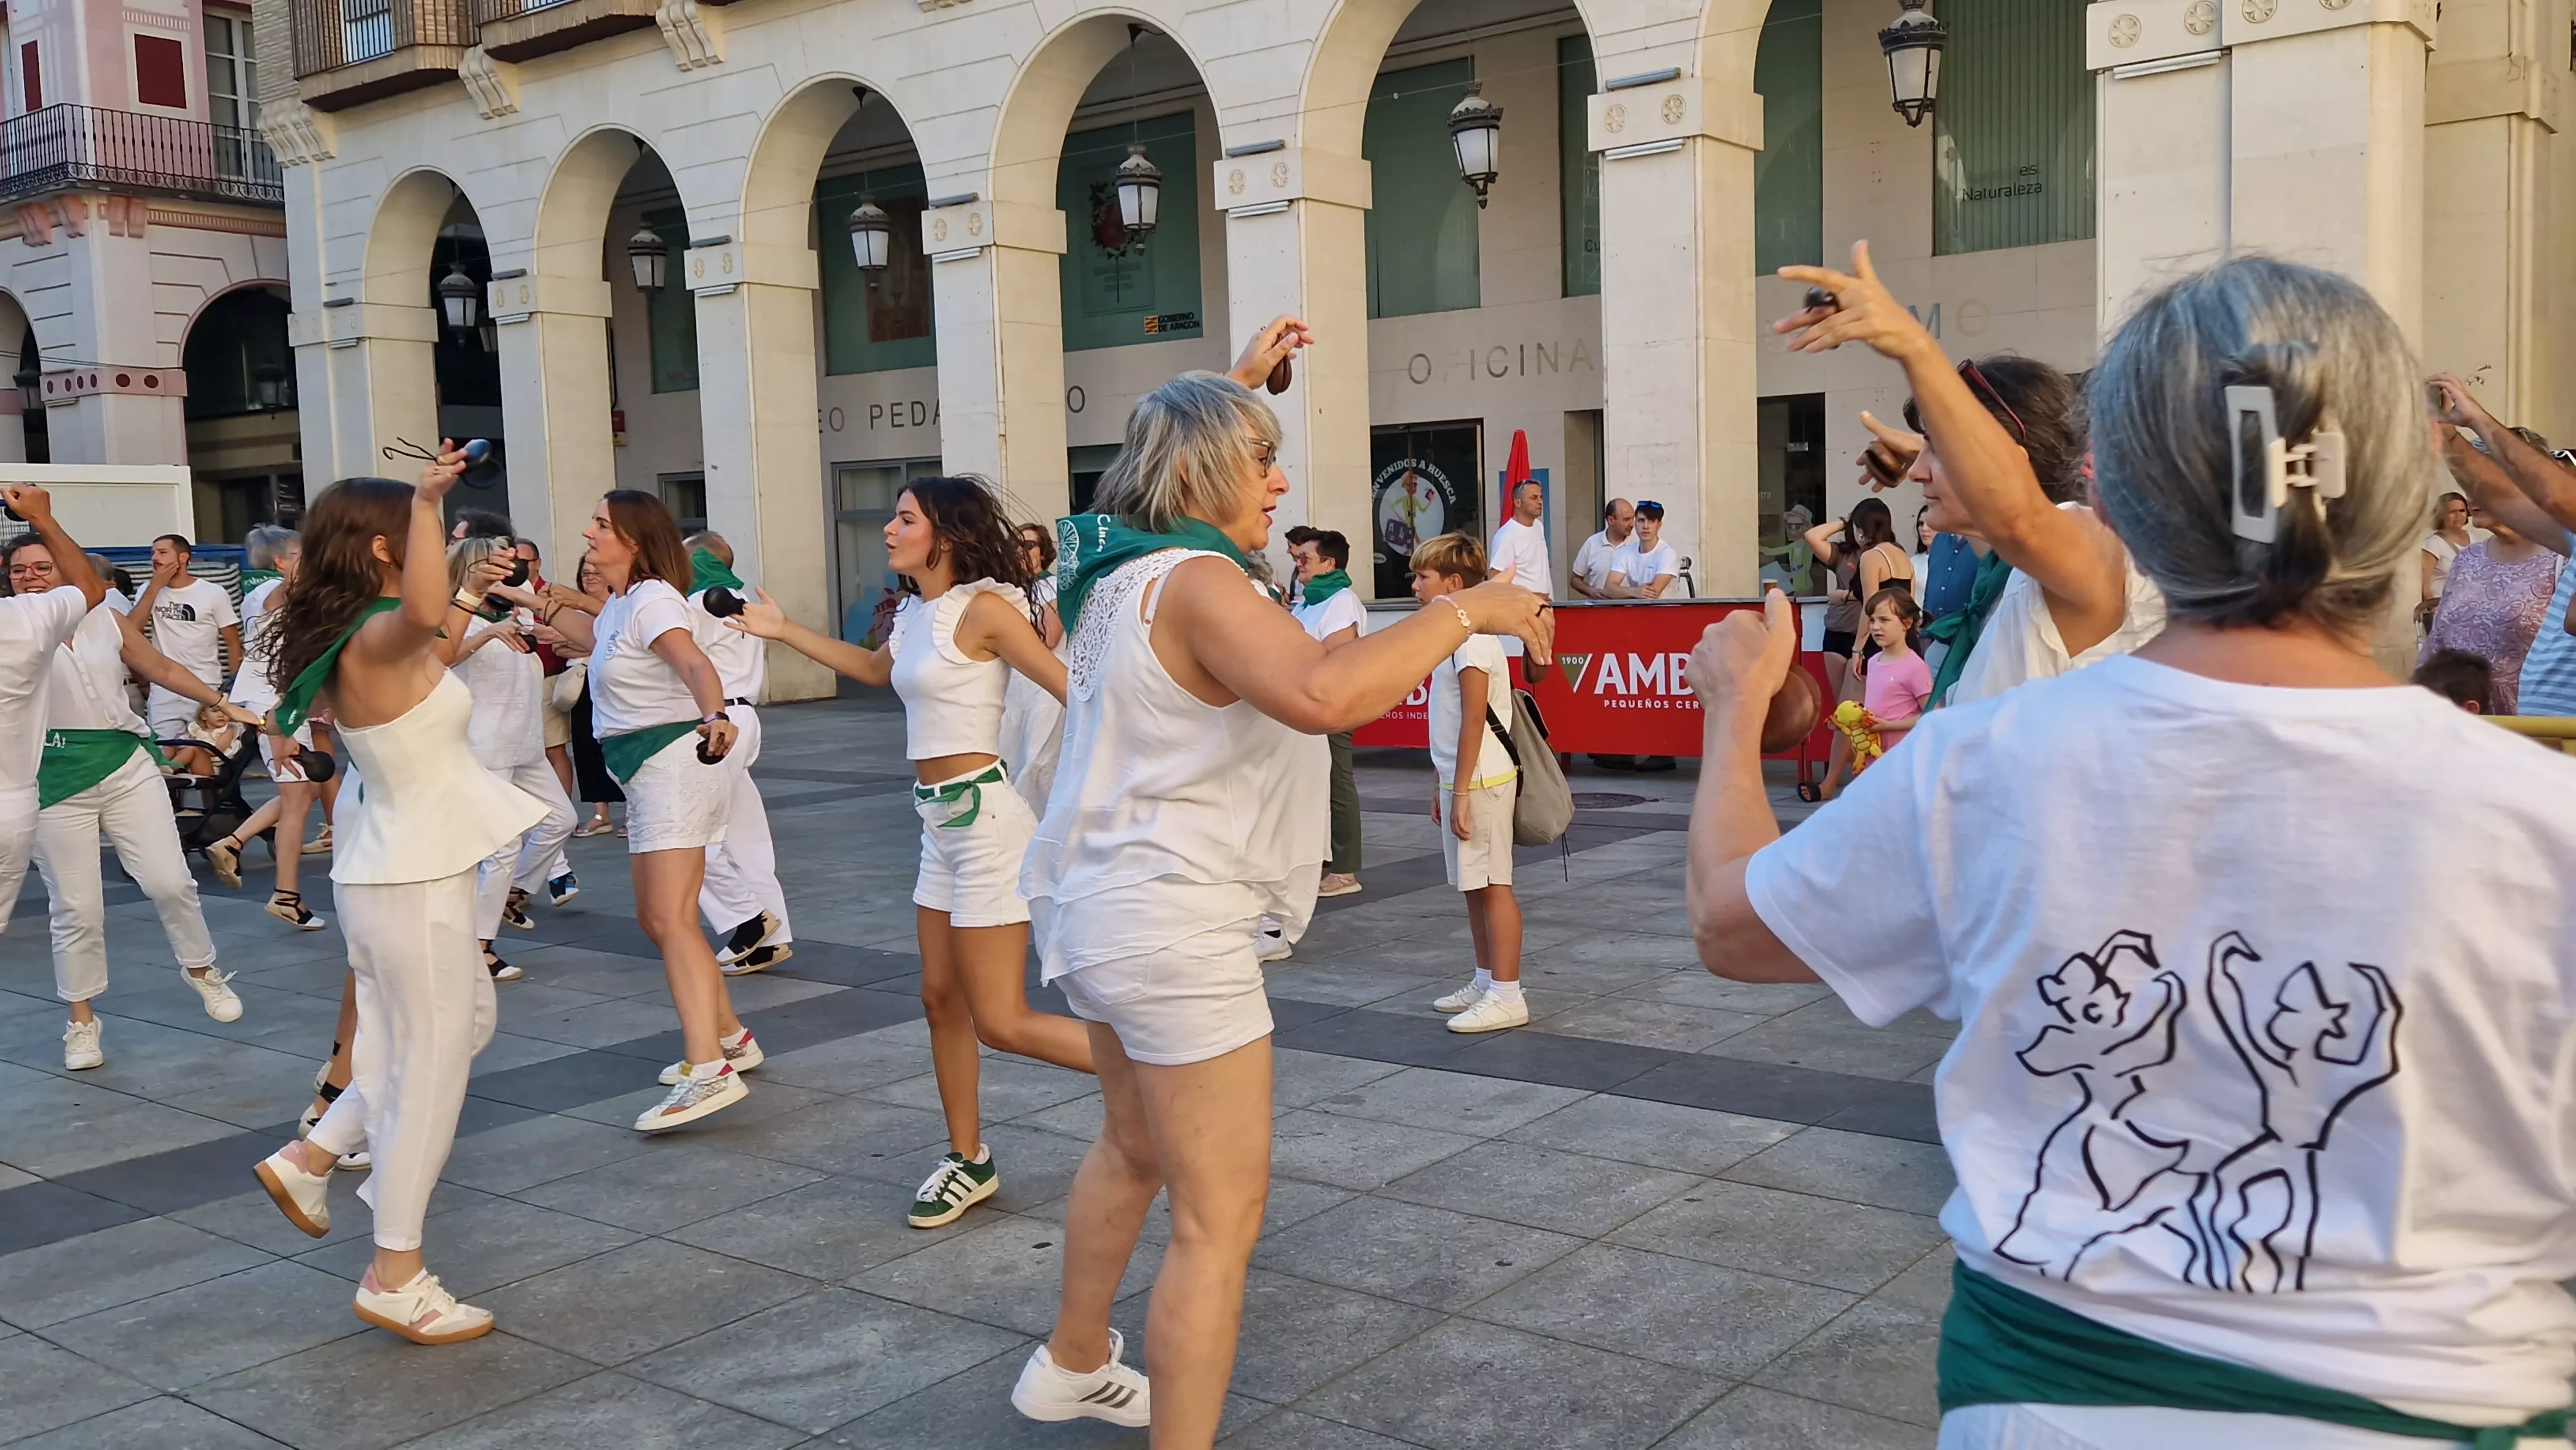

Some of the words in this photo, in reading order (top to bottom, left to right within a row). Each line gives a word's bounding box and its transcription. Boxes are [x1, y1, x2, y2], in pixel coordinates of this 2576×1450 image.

[2020, 165, 2037, 176] es
[1962, 182, 2042, 202] Naturaleza
[1418, 460, 1426, 469] A
[1427, 464, 1457, 505] HUESCA
[1561, 656, 1584, 664] 1900
[1604, 698, 1670, 709] PEQUEÑOS
